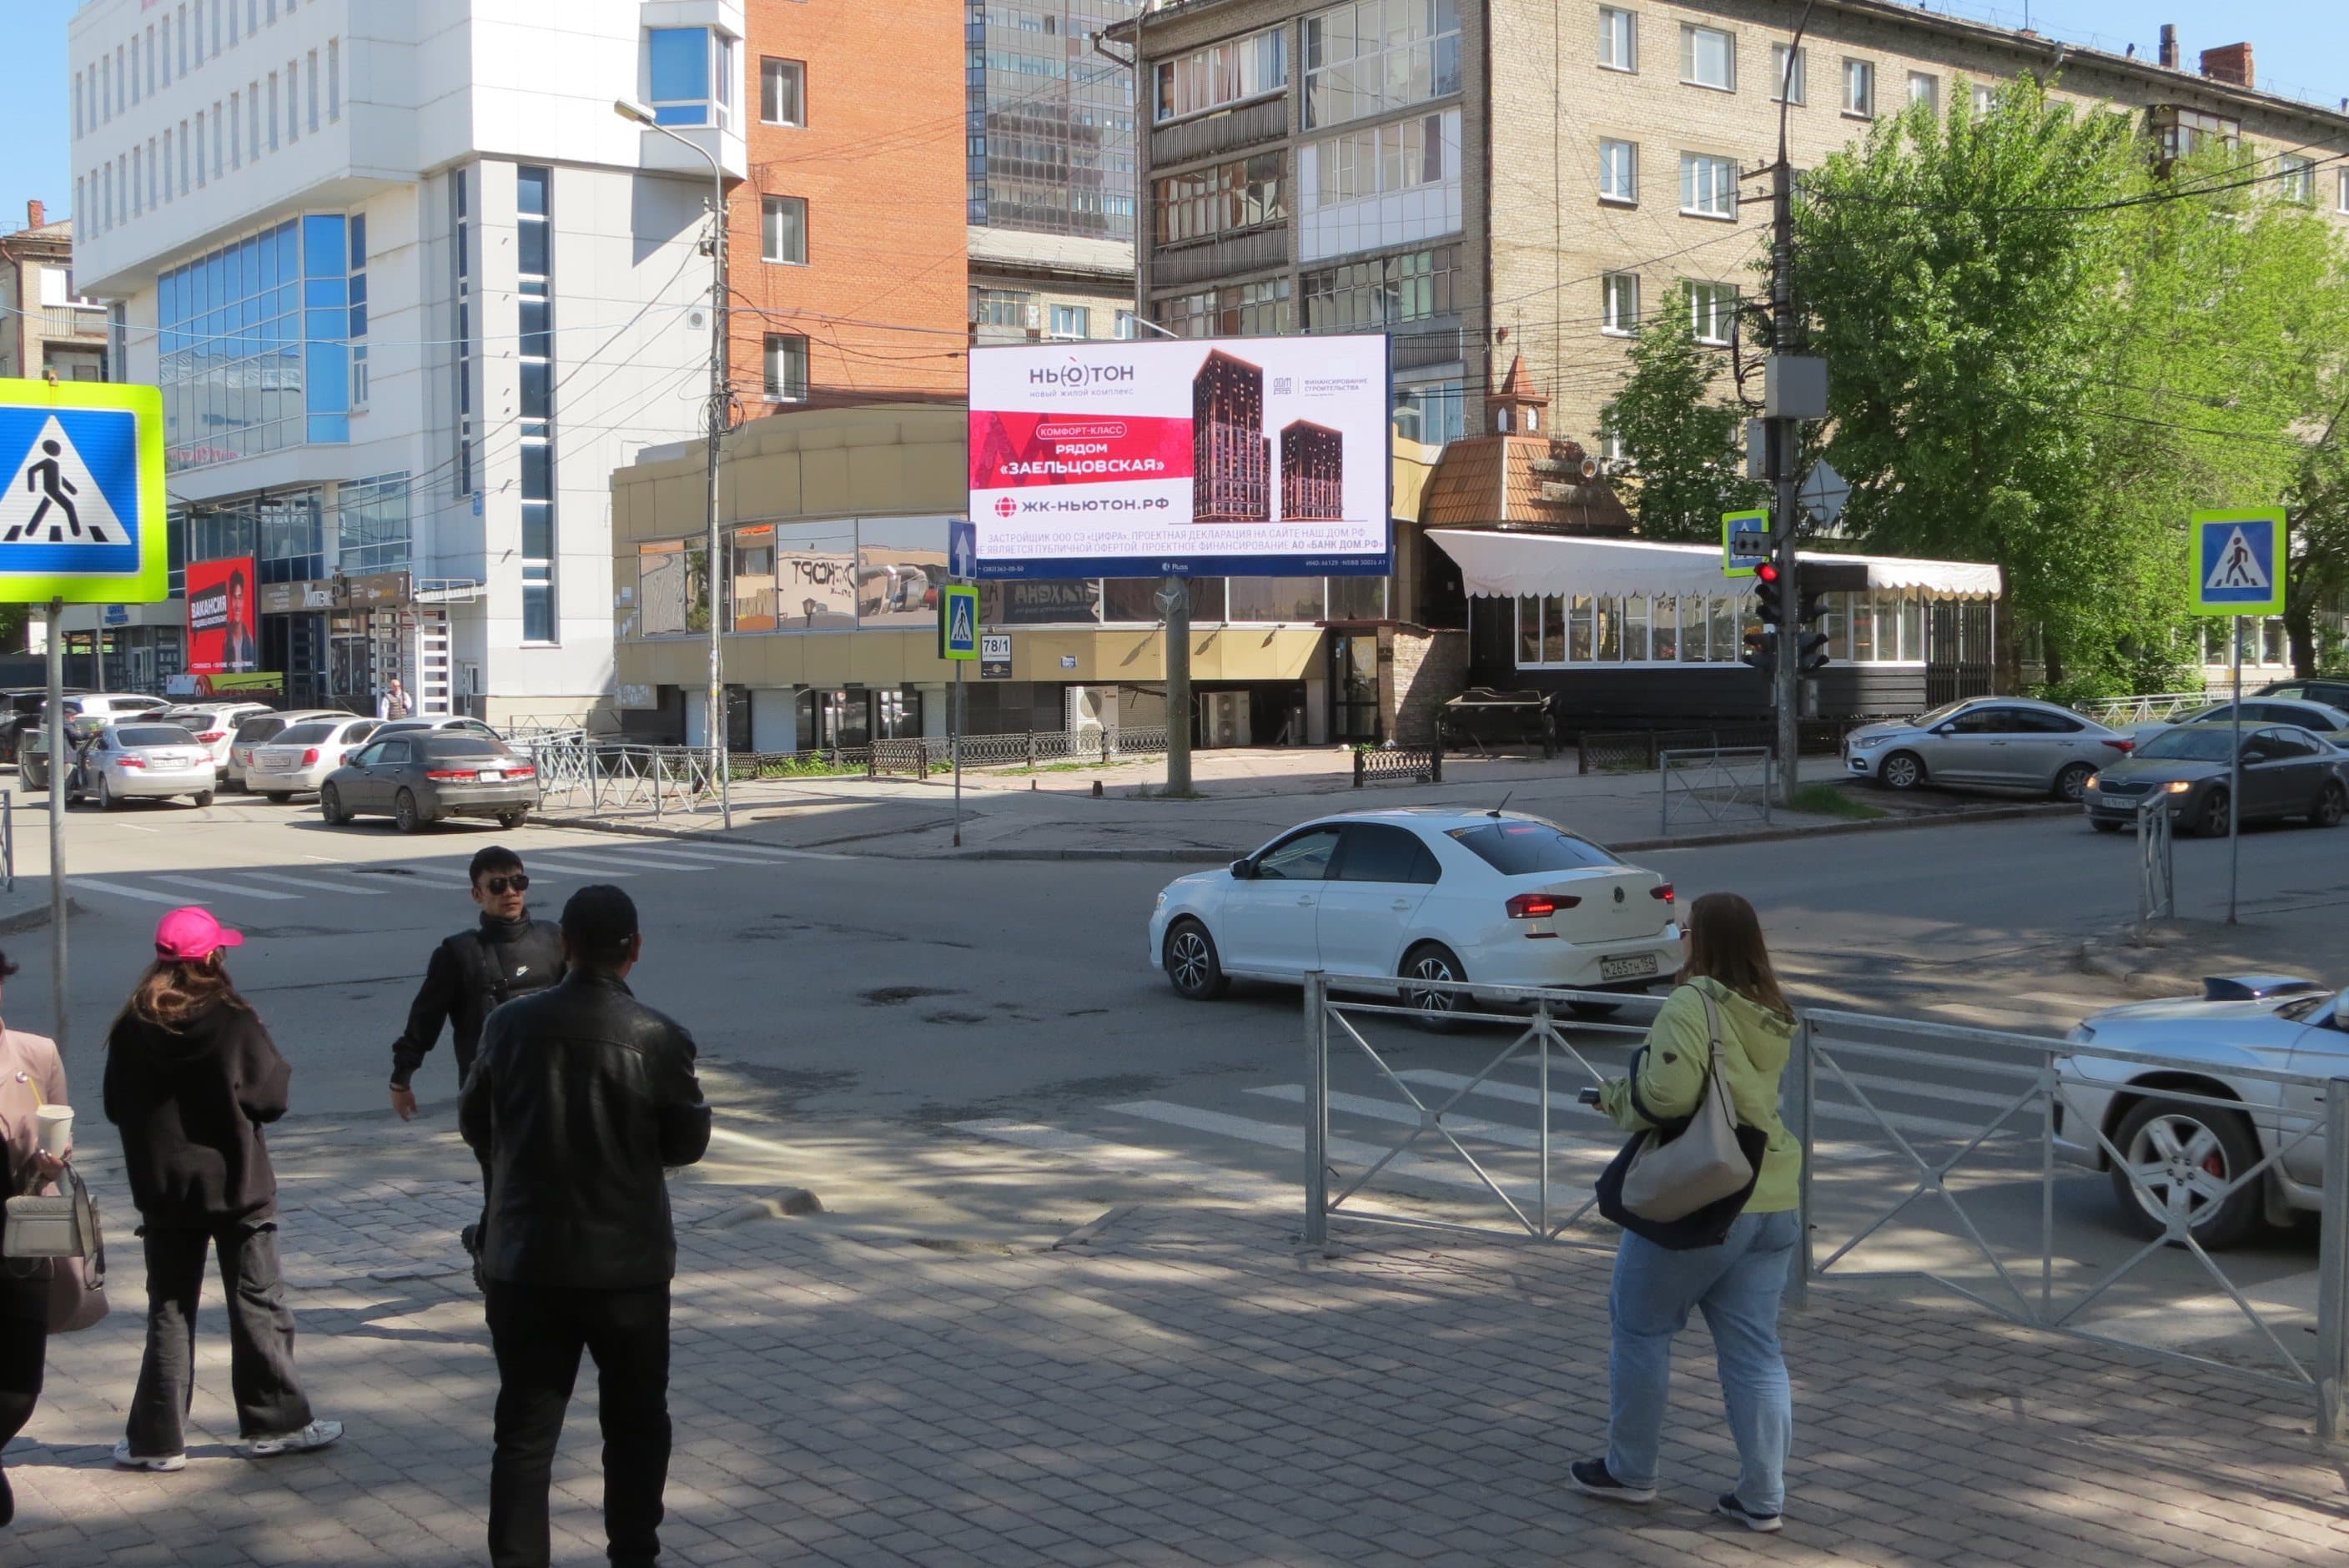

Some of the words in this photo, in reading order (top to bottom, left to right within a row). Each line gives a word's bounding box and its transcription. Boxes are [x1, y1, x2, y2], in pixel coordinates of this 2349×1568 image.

[1029, 389, 1057, 398] новый
[1060, 388, 1089, 398] жилой
[1091, 388, 1134, 396] комплекс
[1040, 425, 1124, 437] КОМФОРТ-КЛАСС
[1055, 444, 1108, 455] РЯДОМ
[1000, 459, 1164, 475] «ЗАЕЛЬЦОВСКАЯ»
[1022, 497, 1169, 513] ЖК-НЬЮТОН.РФ
[988, 531, 1049, 543] ЗАСТРОЙЩИК
[1053, 532, 1071, 541] ООО
[1132, 530, 1186, 540] ПРОЕКТНАЯ
[1189, 530, 1251, 540] ДЕКЛАРАЦИЯ
[1254, 530, 1266, 539] НА
[1269, 527, 1300, 538] САЙТЕ
[987, 545, 1033, 555] ЯВЛЯЕТСЯ
[1035, 542, 1092, 554] ПУБЛИЧНОЙ
[1142, 541, 1196, 551] ПРОЕКТНОЕ
[1199, 540, 1290, 551] ФИНАНСИРОВАНИЕ
[1291, 540, 1305, 550] АО
[1306, 540, 1336, 550] «БАНК
[191, 595, 227, 620] ВАКАНСИЯ
[983, 640, 1009, 652] 78/1
